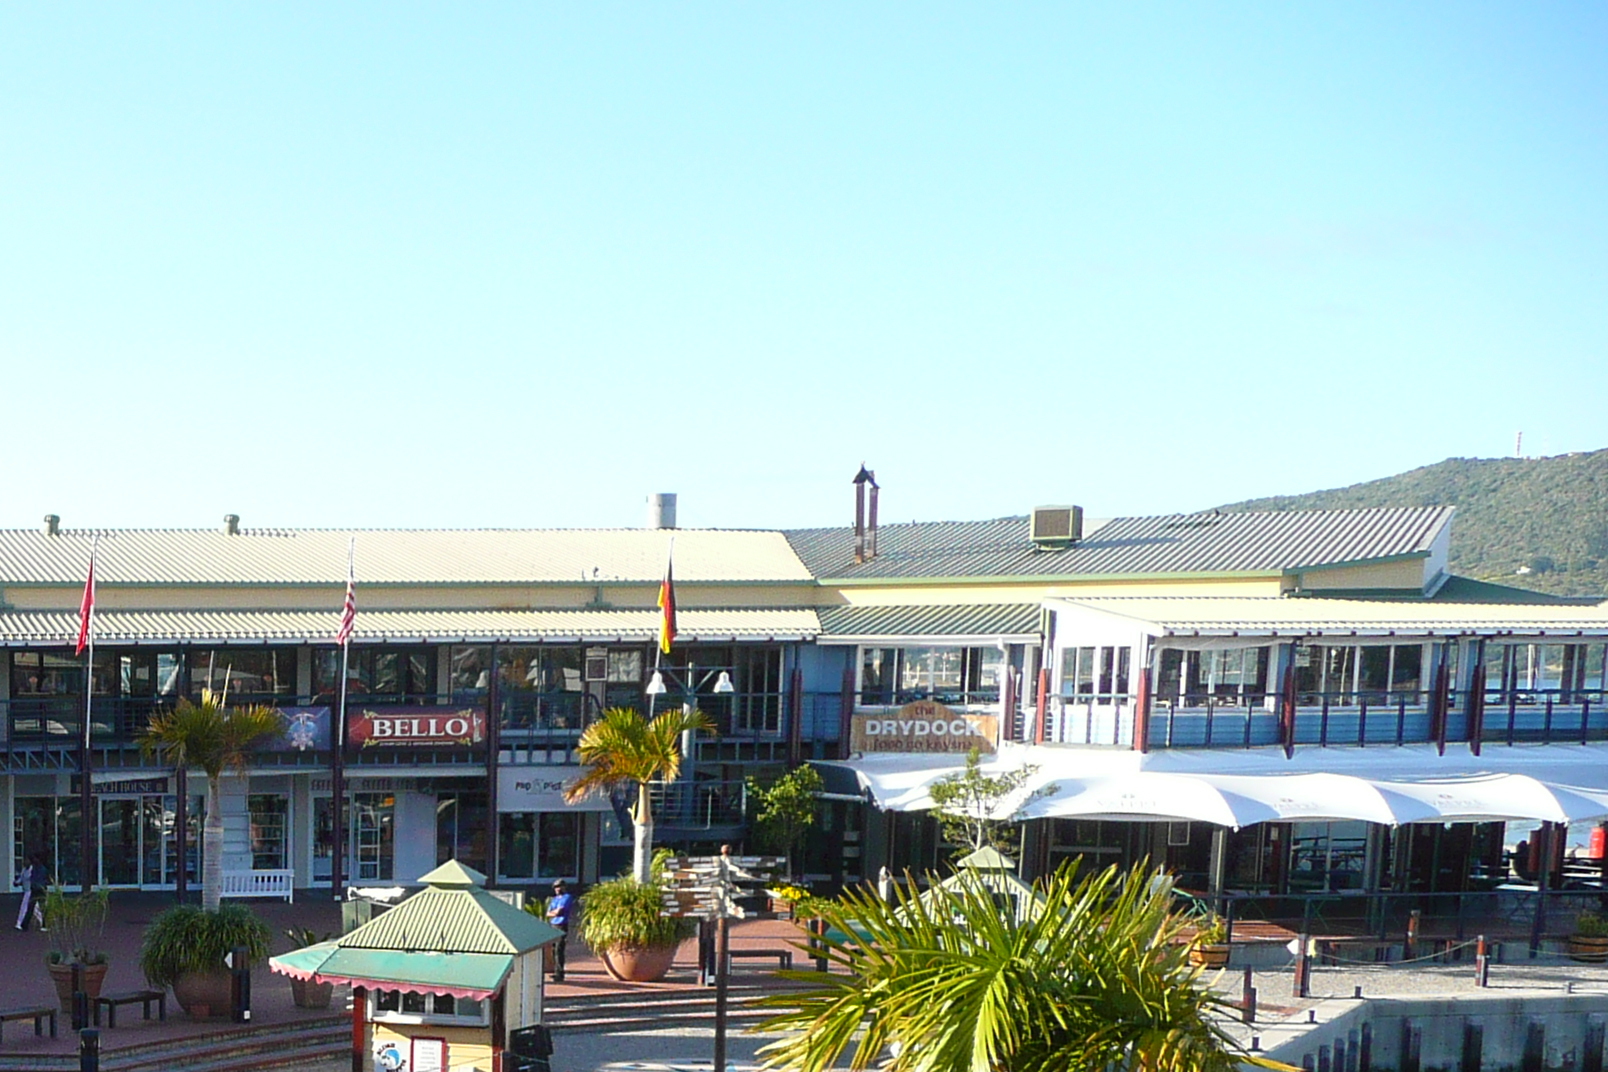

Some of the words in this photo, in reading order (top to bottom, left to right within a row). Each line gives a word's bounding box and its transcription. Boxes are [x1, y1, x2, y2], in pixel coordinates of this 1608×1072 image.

[914, 705, 936, 716] the
[372, 718, 469, 738] BELLO
[865, 719, 983, 737] DRYDOCK
[120, 782, 152, 793] HOUSE
